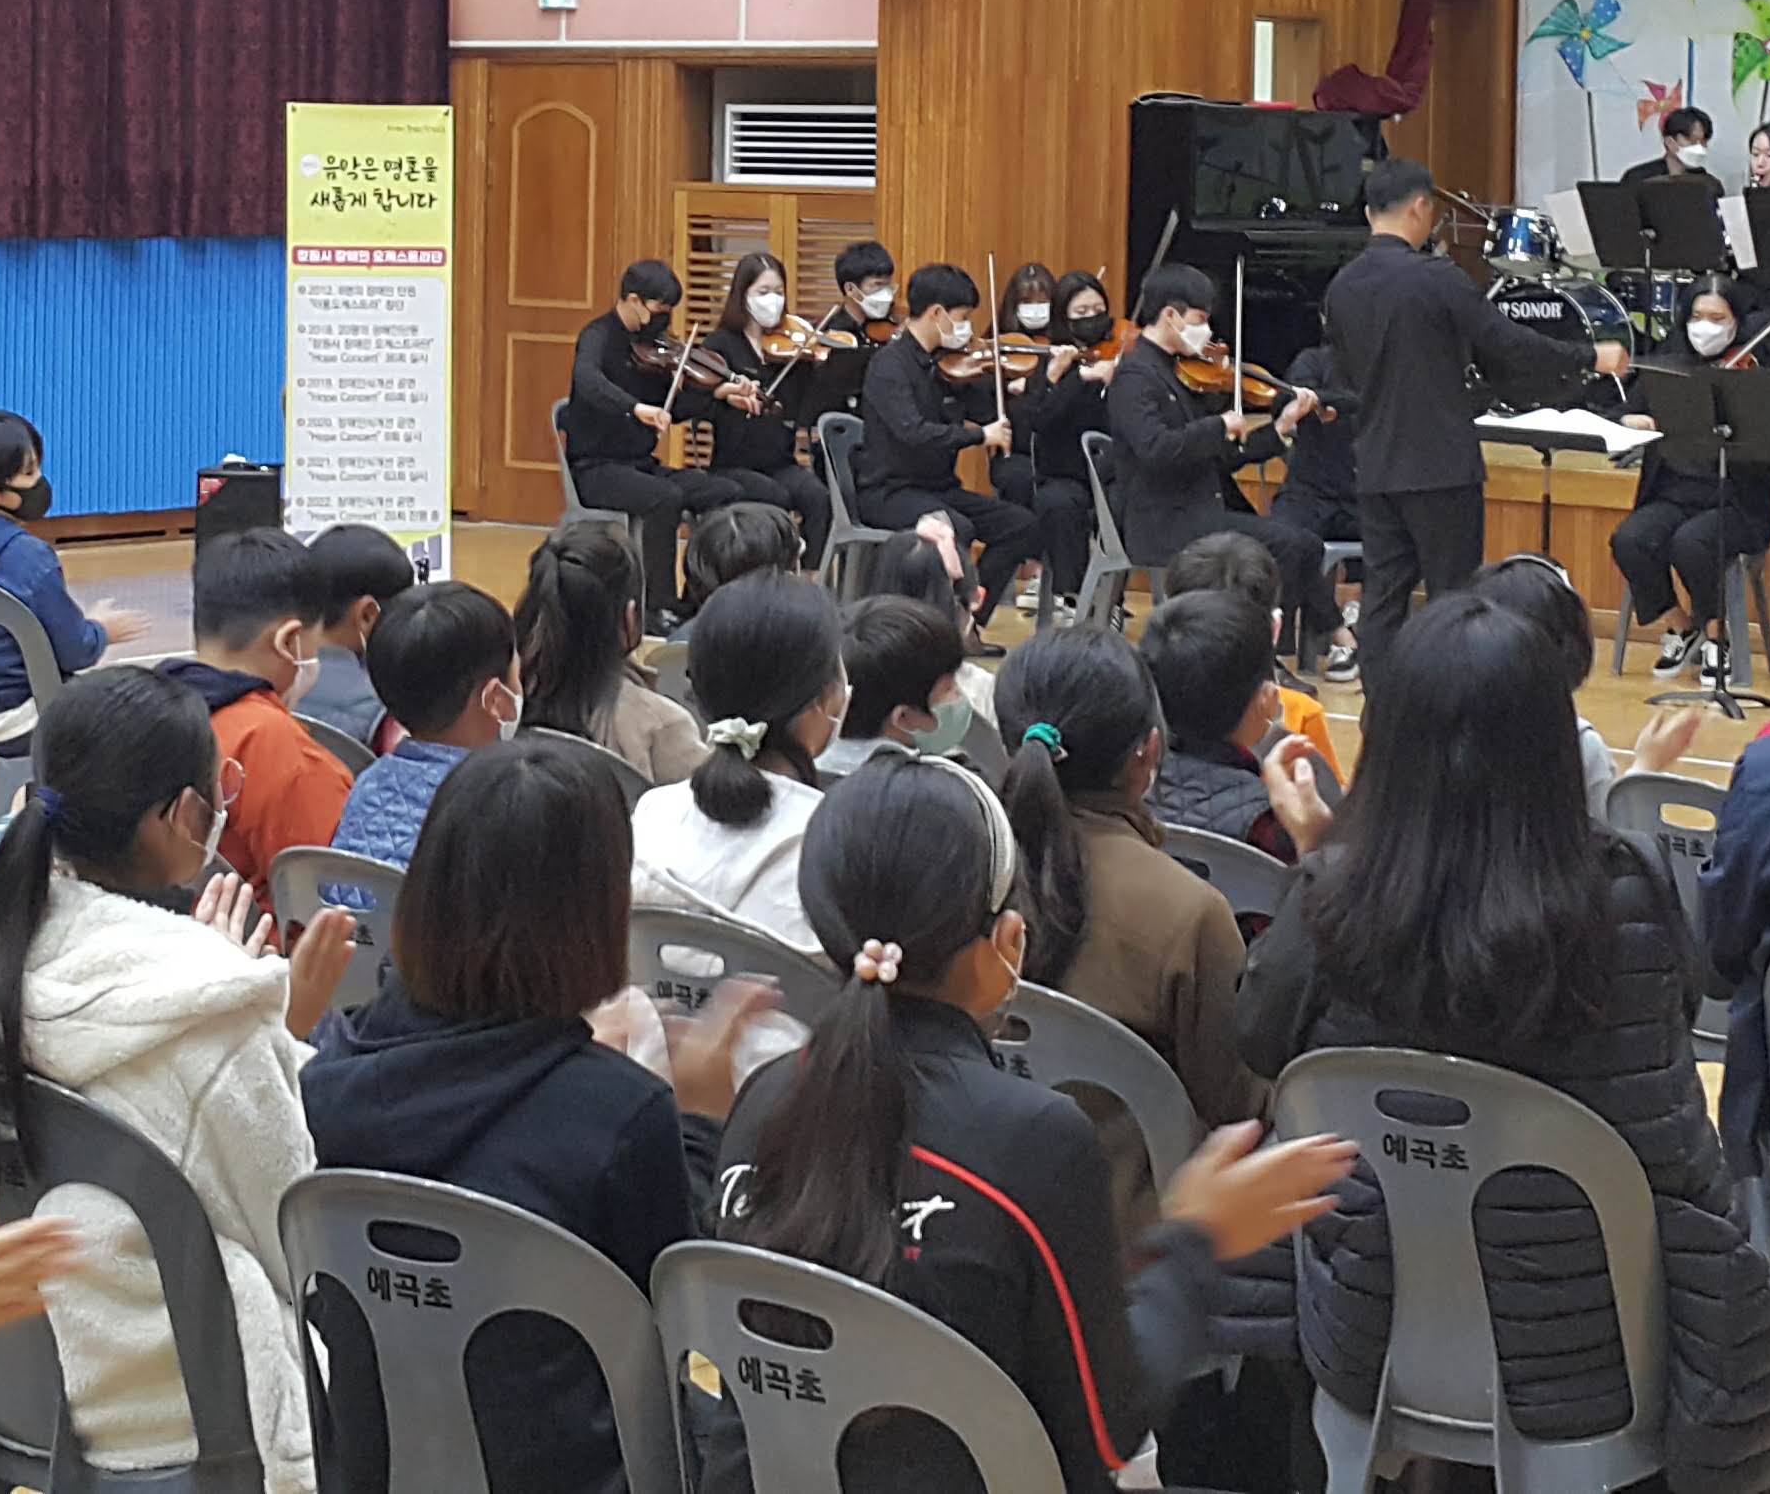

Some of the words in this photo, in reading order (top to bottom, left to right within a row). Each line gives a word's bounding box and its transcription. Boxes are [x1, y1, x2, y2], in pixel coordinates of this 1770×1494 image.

[323, 155, 379, 181] 음악은
[384, 156, 438, 182] 영혼을
[310, 186, 367, 212] 새롭게
[373, 188, 438, 212] 합니다
[1510, 301, 1563, 320] SONOR
[1382, 1133, 1470, 1170] 예곡초
[367, 1266, 453, 1309] 예곡초
[737, 1355, 828, 1405] 예곡초
